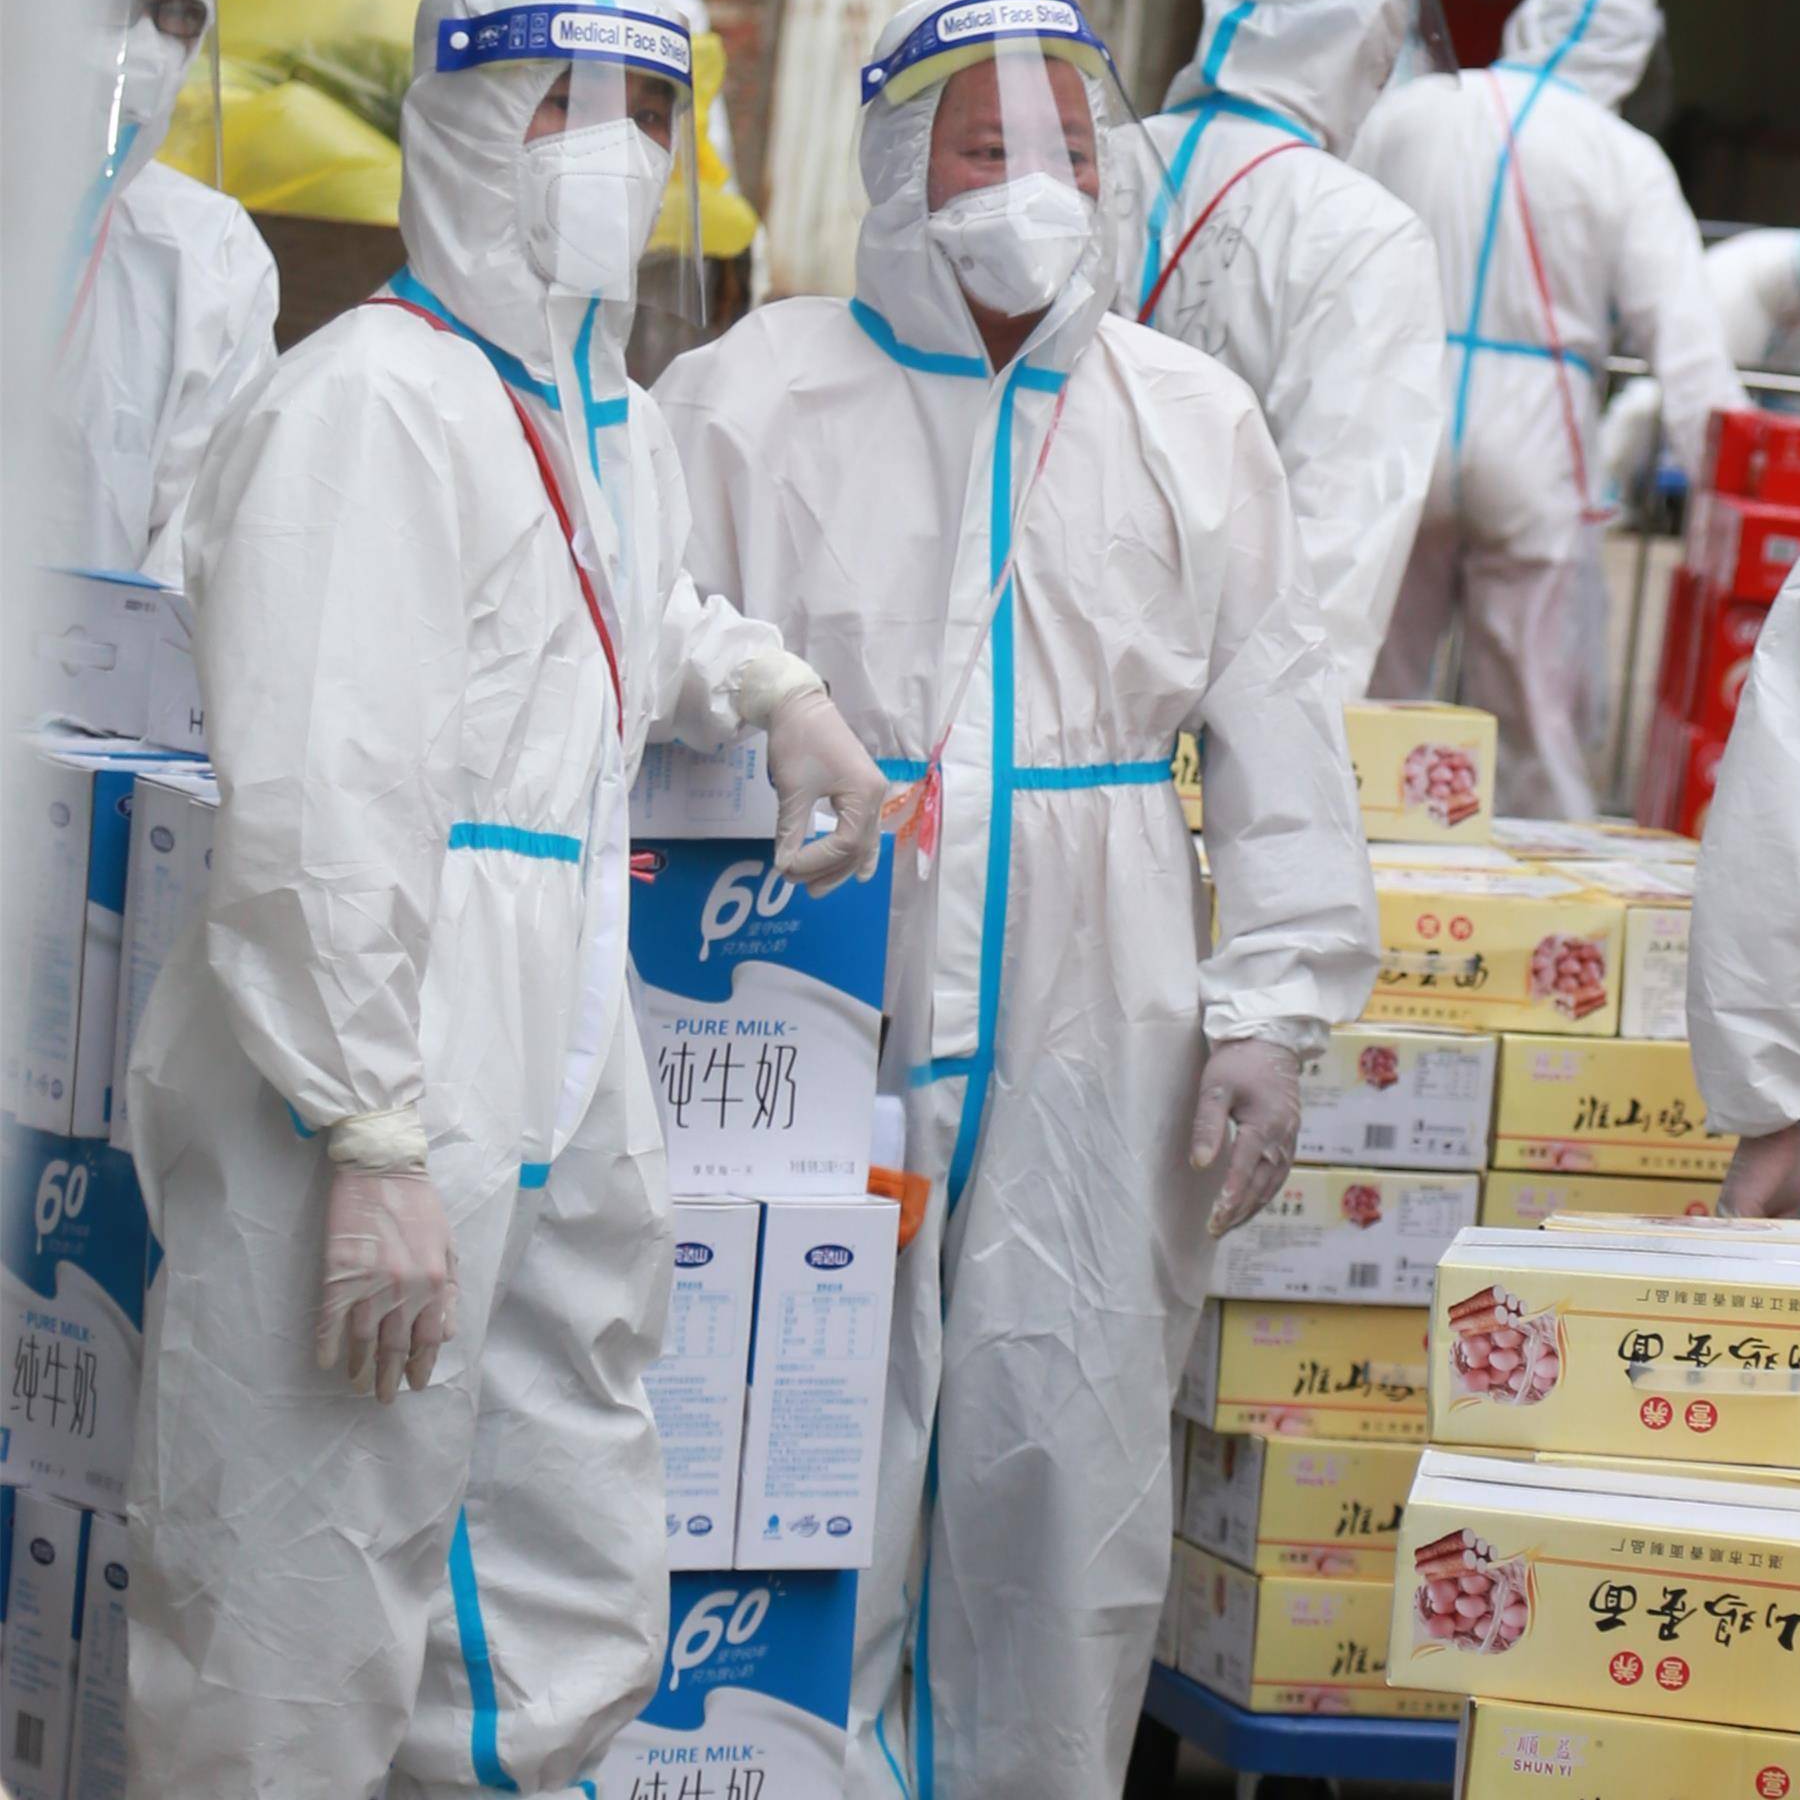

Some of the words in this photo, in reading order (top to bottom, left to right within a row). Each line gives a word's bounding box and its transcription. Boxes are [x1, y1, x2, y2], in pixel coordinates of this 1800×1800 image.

[560, 20, 620, 46] Medical
[624, 26, 656, 53] Face
[944, 7, 996, 35] Medical
[1001, 6, 1034, 24] Face
[1038, 5, 1074, 27] Shield
[658, 1042, 797, 1129] 纯牛奶
[10, 1333, 97, 1439] 纯牛奶
[669, 1587, 771, 1692] 60
[1513, 1759, 1554, 1775] SHUN
[1560, 1764, 1573, 1777] YI
